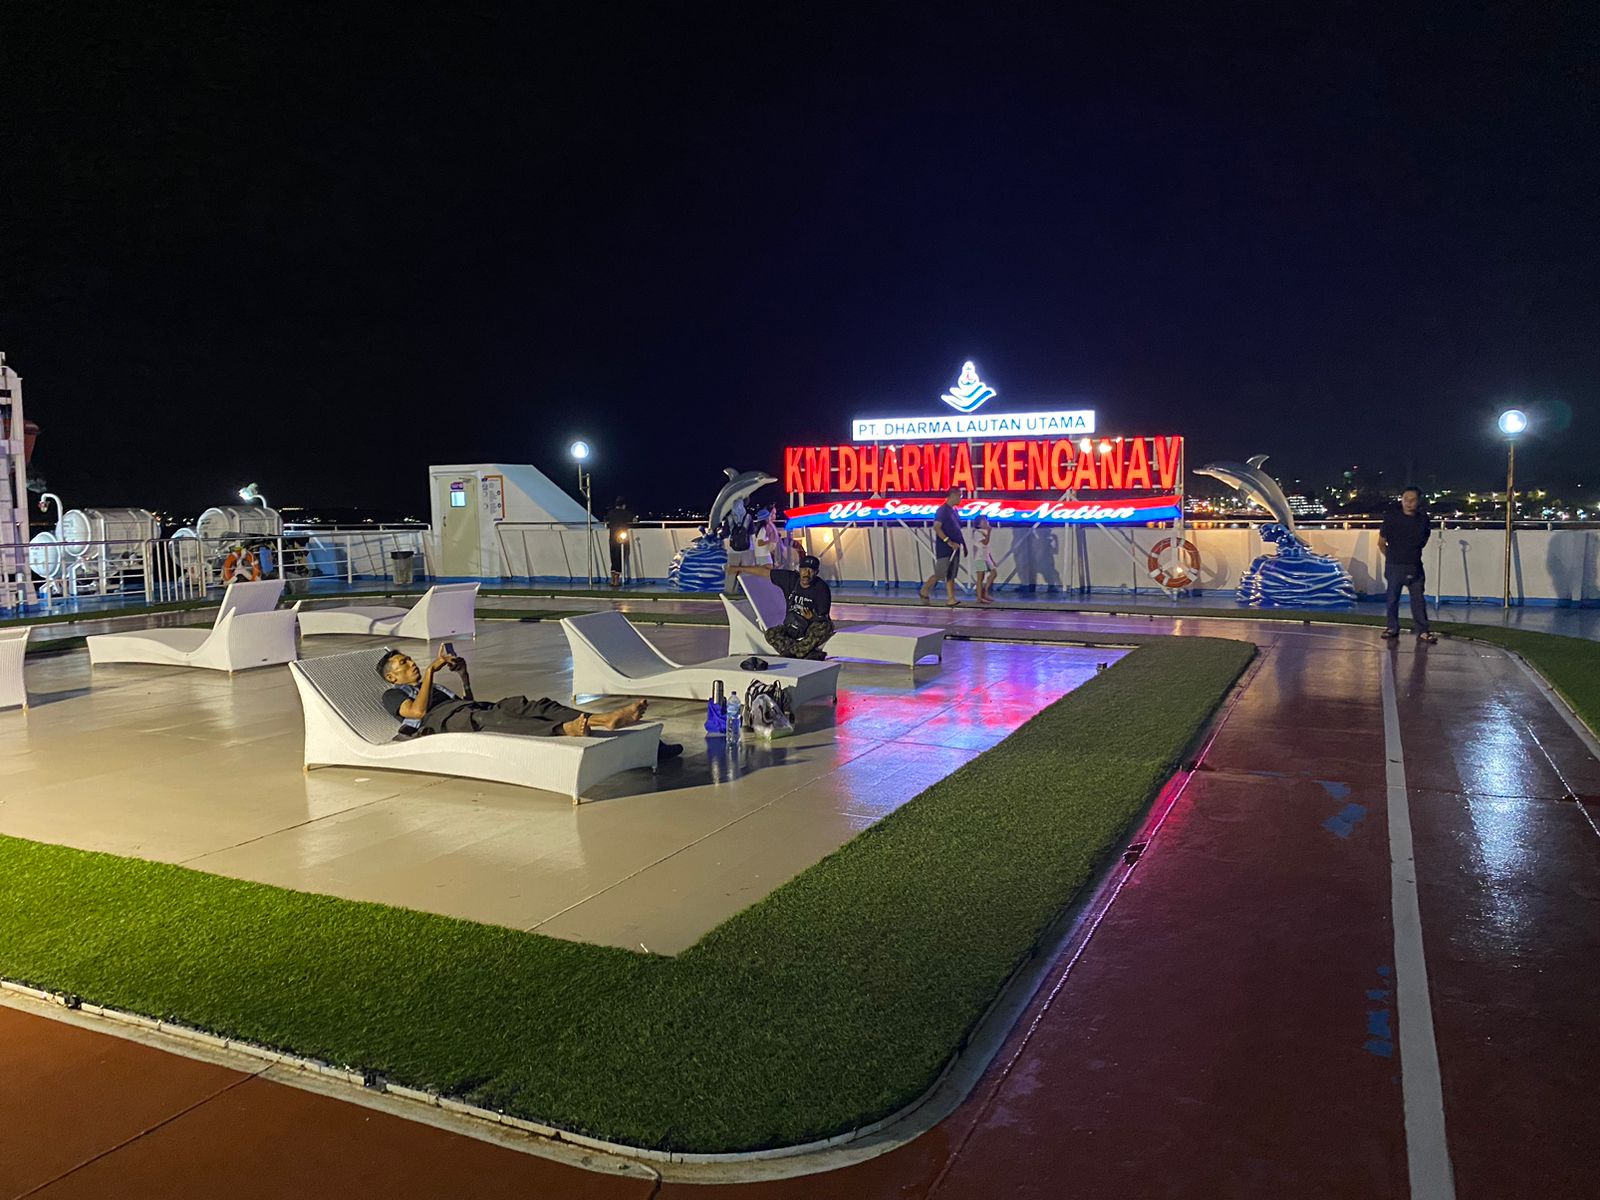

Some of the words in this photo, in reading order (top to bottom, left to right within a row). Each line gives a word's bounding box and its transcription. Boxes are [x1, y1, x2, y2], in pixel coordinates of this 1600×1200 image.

[884, 421, 952, 436] DHARMA
[956, 417, 1021, 432] LAUTAN
[1026, 415, 1086, 430] UTAMA
[785, 447, 830, 493] KM
[837, 442, 976, 493] DHARMA
[983, 437, 1153, 491] KENCANA
[827, 503, 873, 520] We
[957, 501, 1015, 519] The
[1021, 502, 1136, 521] Nation
